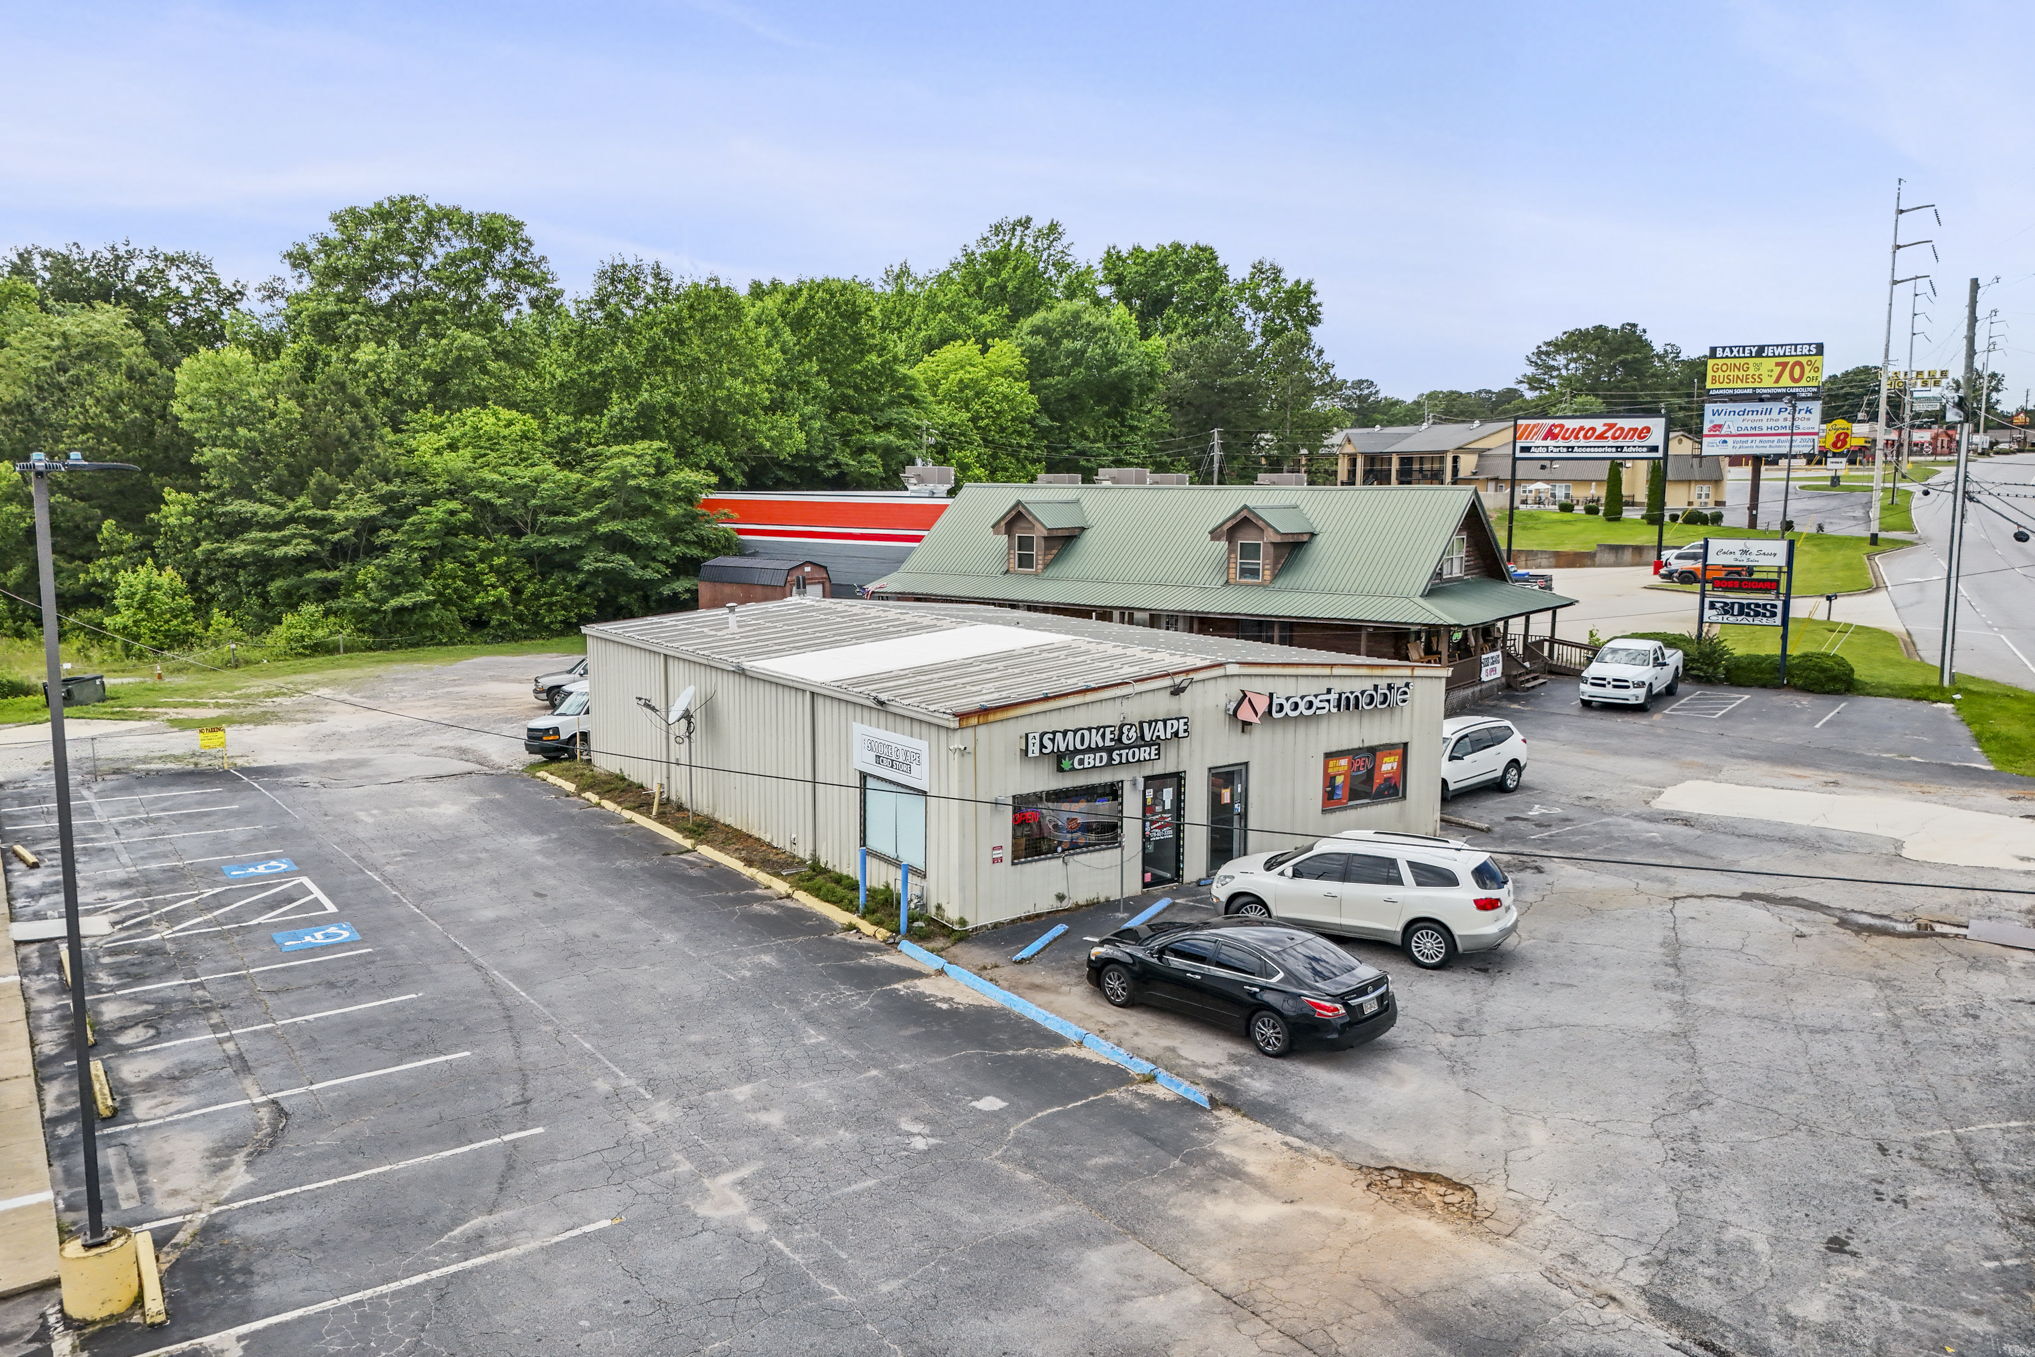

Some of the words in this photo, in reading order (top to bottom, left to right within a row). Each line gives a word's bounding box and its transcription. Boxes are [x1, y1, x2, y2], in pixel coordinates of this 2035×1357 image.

[1716, 346, 1758, 357] BAXLEY
[1762, 344, 1817, 356] JEWELERS
[1711, 362, 1750, 373] GOING
[1773, 359, 1820, 384] 70%
[1710, 373, 1763, 385] BUSINESS
[1886, 379, 1943, 388] HOSE
[1711, 407, 1773, 417] Windmill
[1541, 422, 1653, 442] AutoZone
[1828, 423, 1850, 434] Super
[1831, 431, 1850, 450] 8
[1715, 548, 1736, 556] Color
[1738, 548, 1753, 556] Me
[1755, 549, 1778, 557] Sassy
[1713, 580, 1739, 588] BOSS
[1741, 581, 1777, 590] CIGARS
[1708, 600, 1778, 618] BOSS
[1708, 614, 1777, 624] CIGARS
[1041, 726, 1116, 754] SMOKE
[1121, 724, 1138, 745] &
[1141, 717, 1190, 742] VAPE
[866, 738, 893, 758] SMOKE
[901, 748, 921, 766] VAPE
[1073, 752, 1108, 770] CBD
[1111, 745, 1159, 765] STORE
[880, 757, 892, 769] CBD
[892, 761, 912, 774] STORE
[1350, 757, 1371, 772] OPEN
[1012, 811, 1039, 825] OPEN
